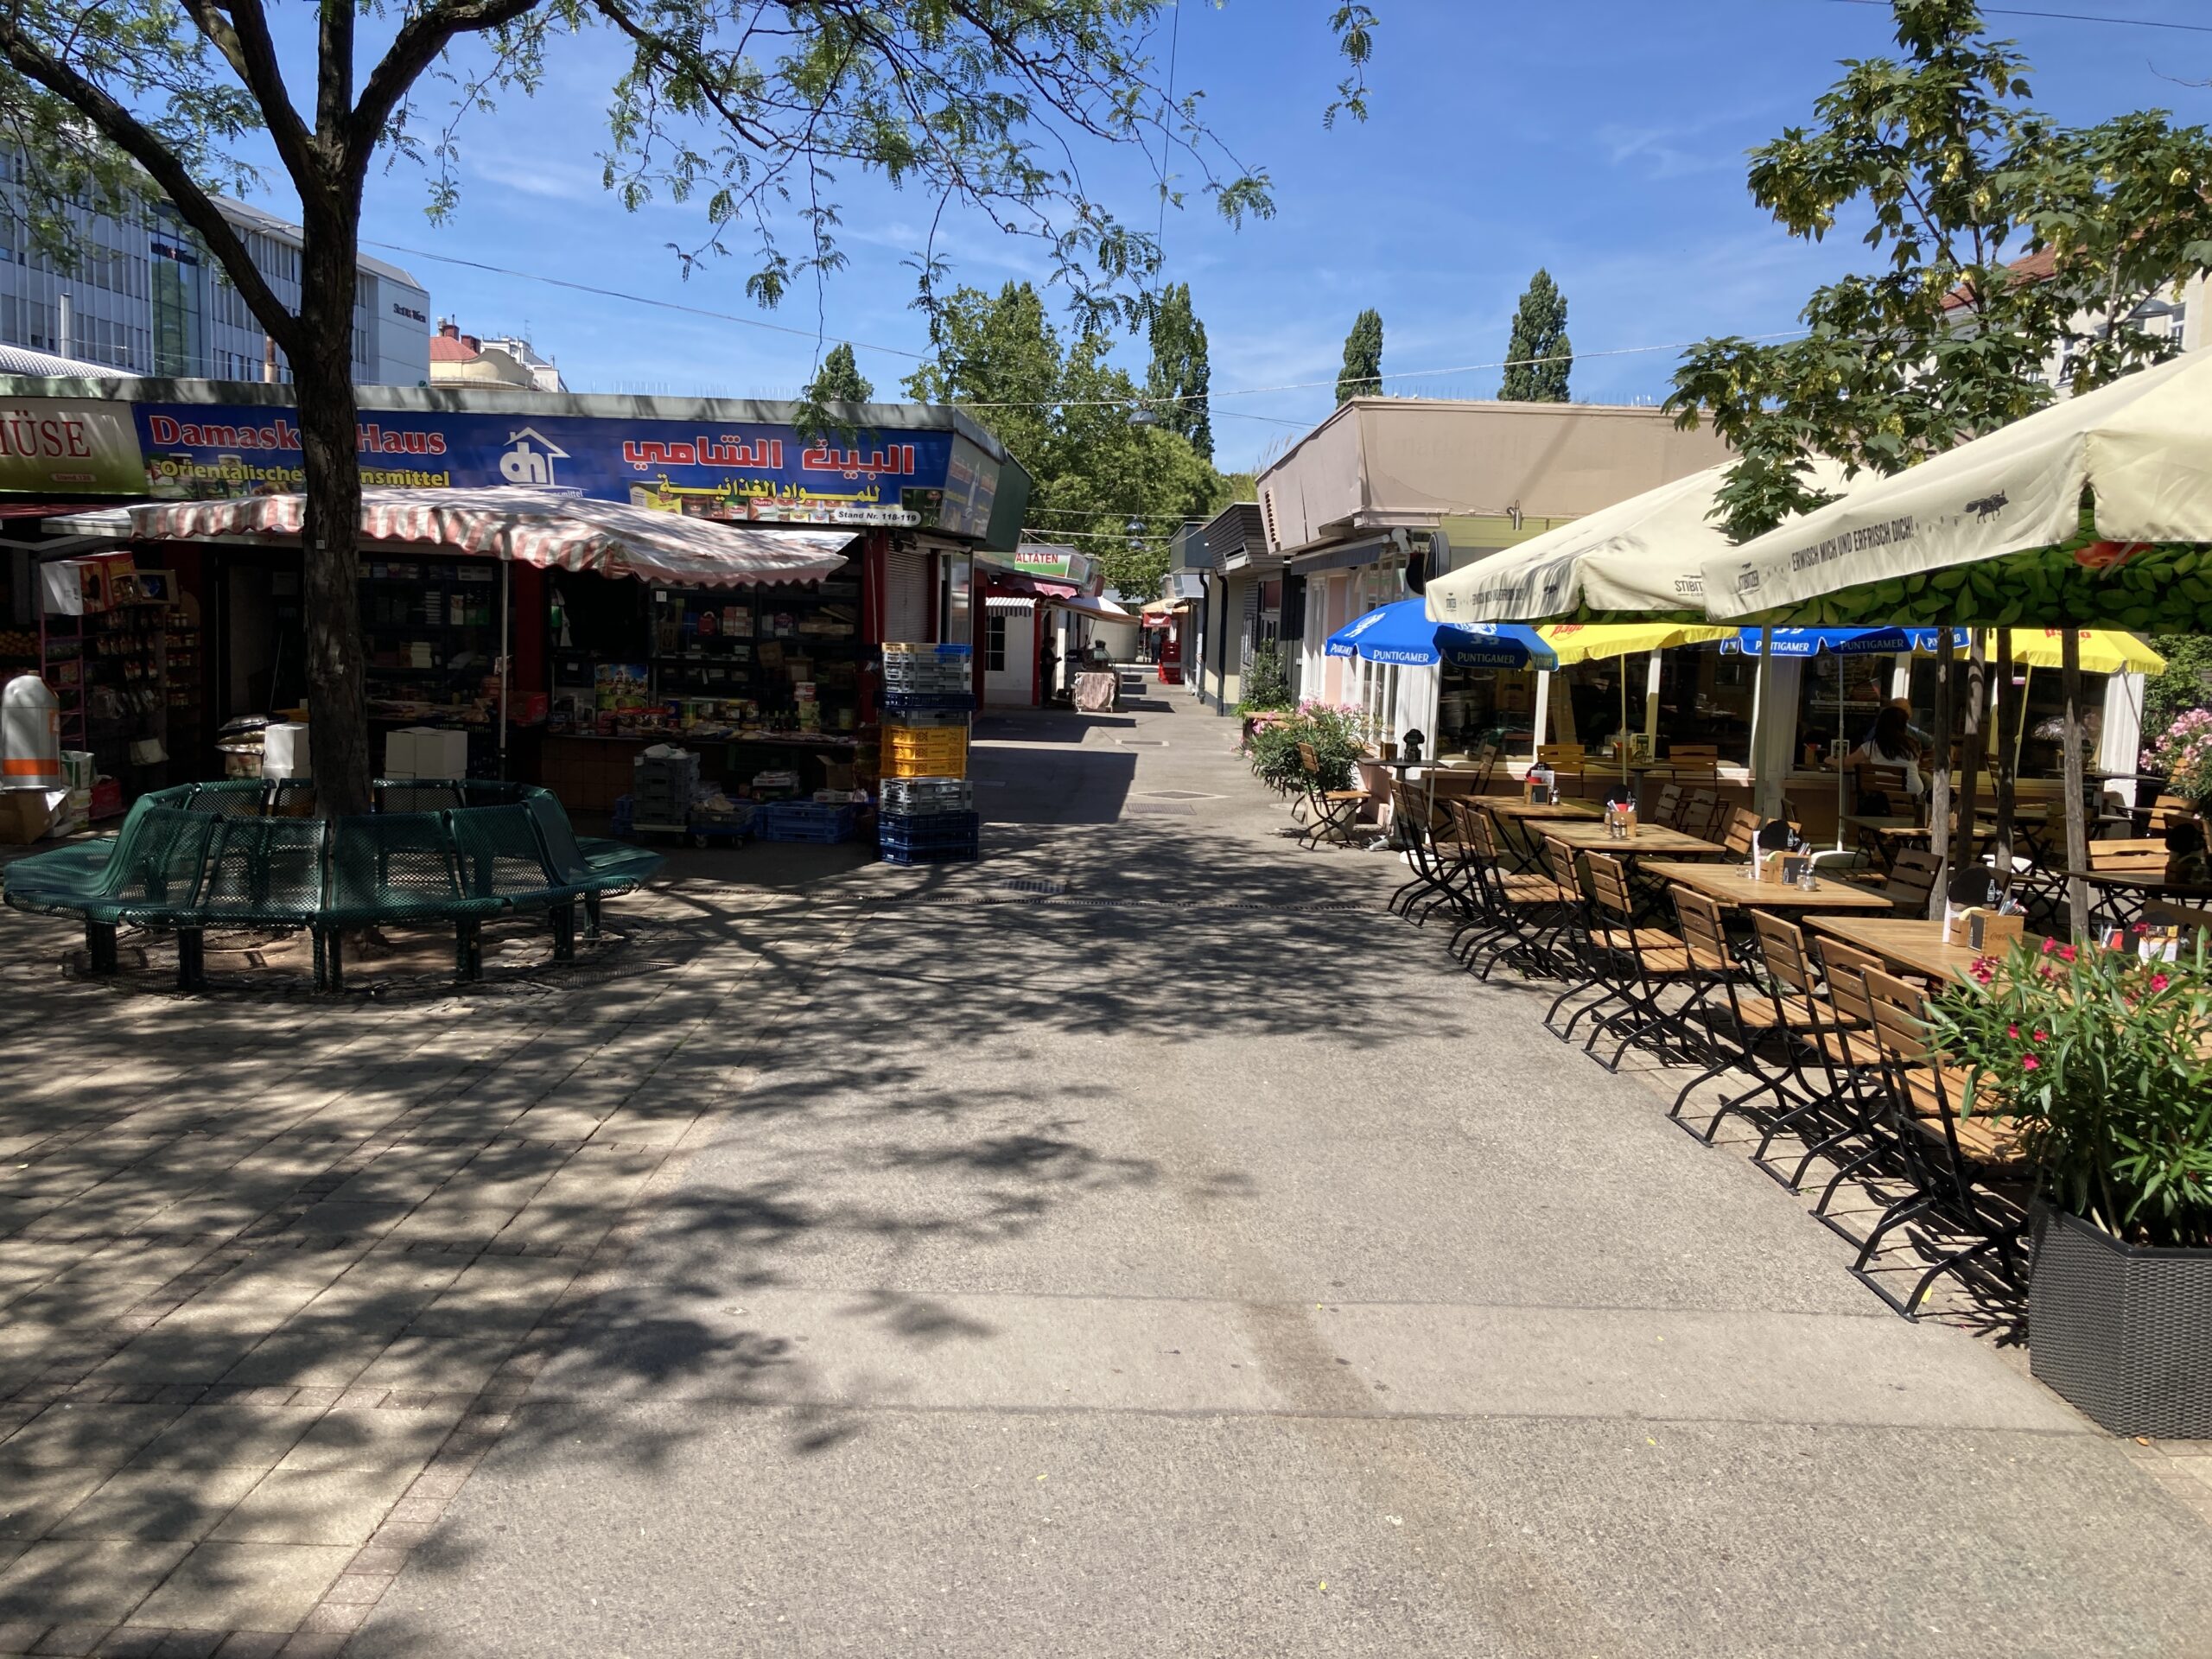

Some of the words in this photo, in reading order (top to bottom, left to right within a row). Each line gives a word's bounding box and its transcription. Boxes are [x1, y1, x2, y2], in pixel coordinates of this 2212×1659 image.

[149, 416, 302, 450] Damask
[357, 423, 447, 454] Haus
[623, 435, 783, 471] الشامي
[160, 460, 302, 482] Orientalische
[360, 469, 450, 487] nsmittel
[838, 511, 864, 519] Stand
[882, 513, 917, 522] 118-119
[1791, 544, 1820, 572] ERWISCH
[1820, 540, 1838, 563] MICH
[1838, 532, 1853, 556] UND
[1853, 522, 1891, 551] ERFRISCH
[1891, 515, 1915, 543] DICH!
[1675, 580, 1703, 592] STIBIT
[1755, 640, 1809, 652] PTIGAMER
[1840, 639, 1904, 651] PUNTIGAMER
[1373, 650, 1430, 663] PUNTIGAMER
[1457, 651, 1515, 664] PUNTIGAMER
